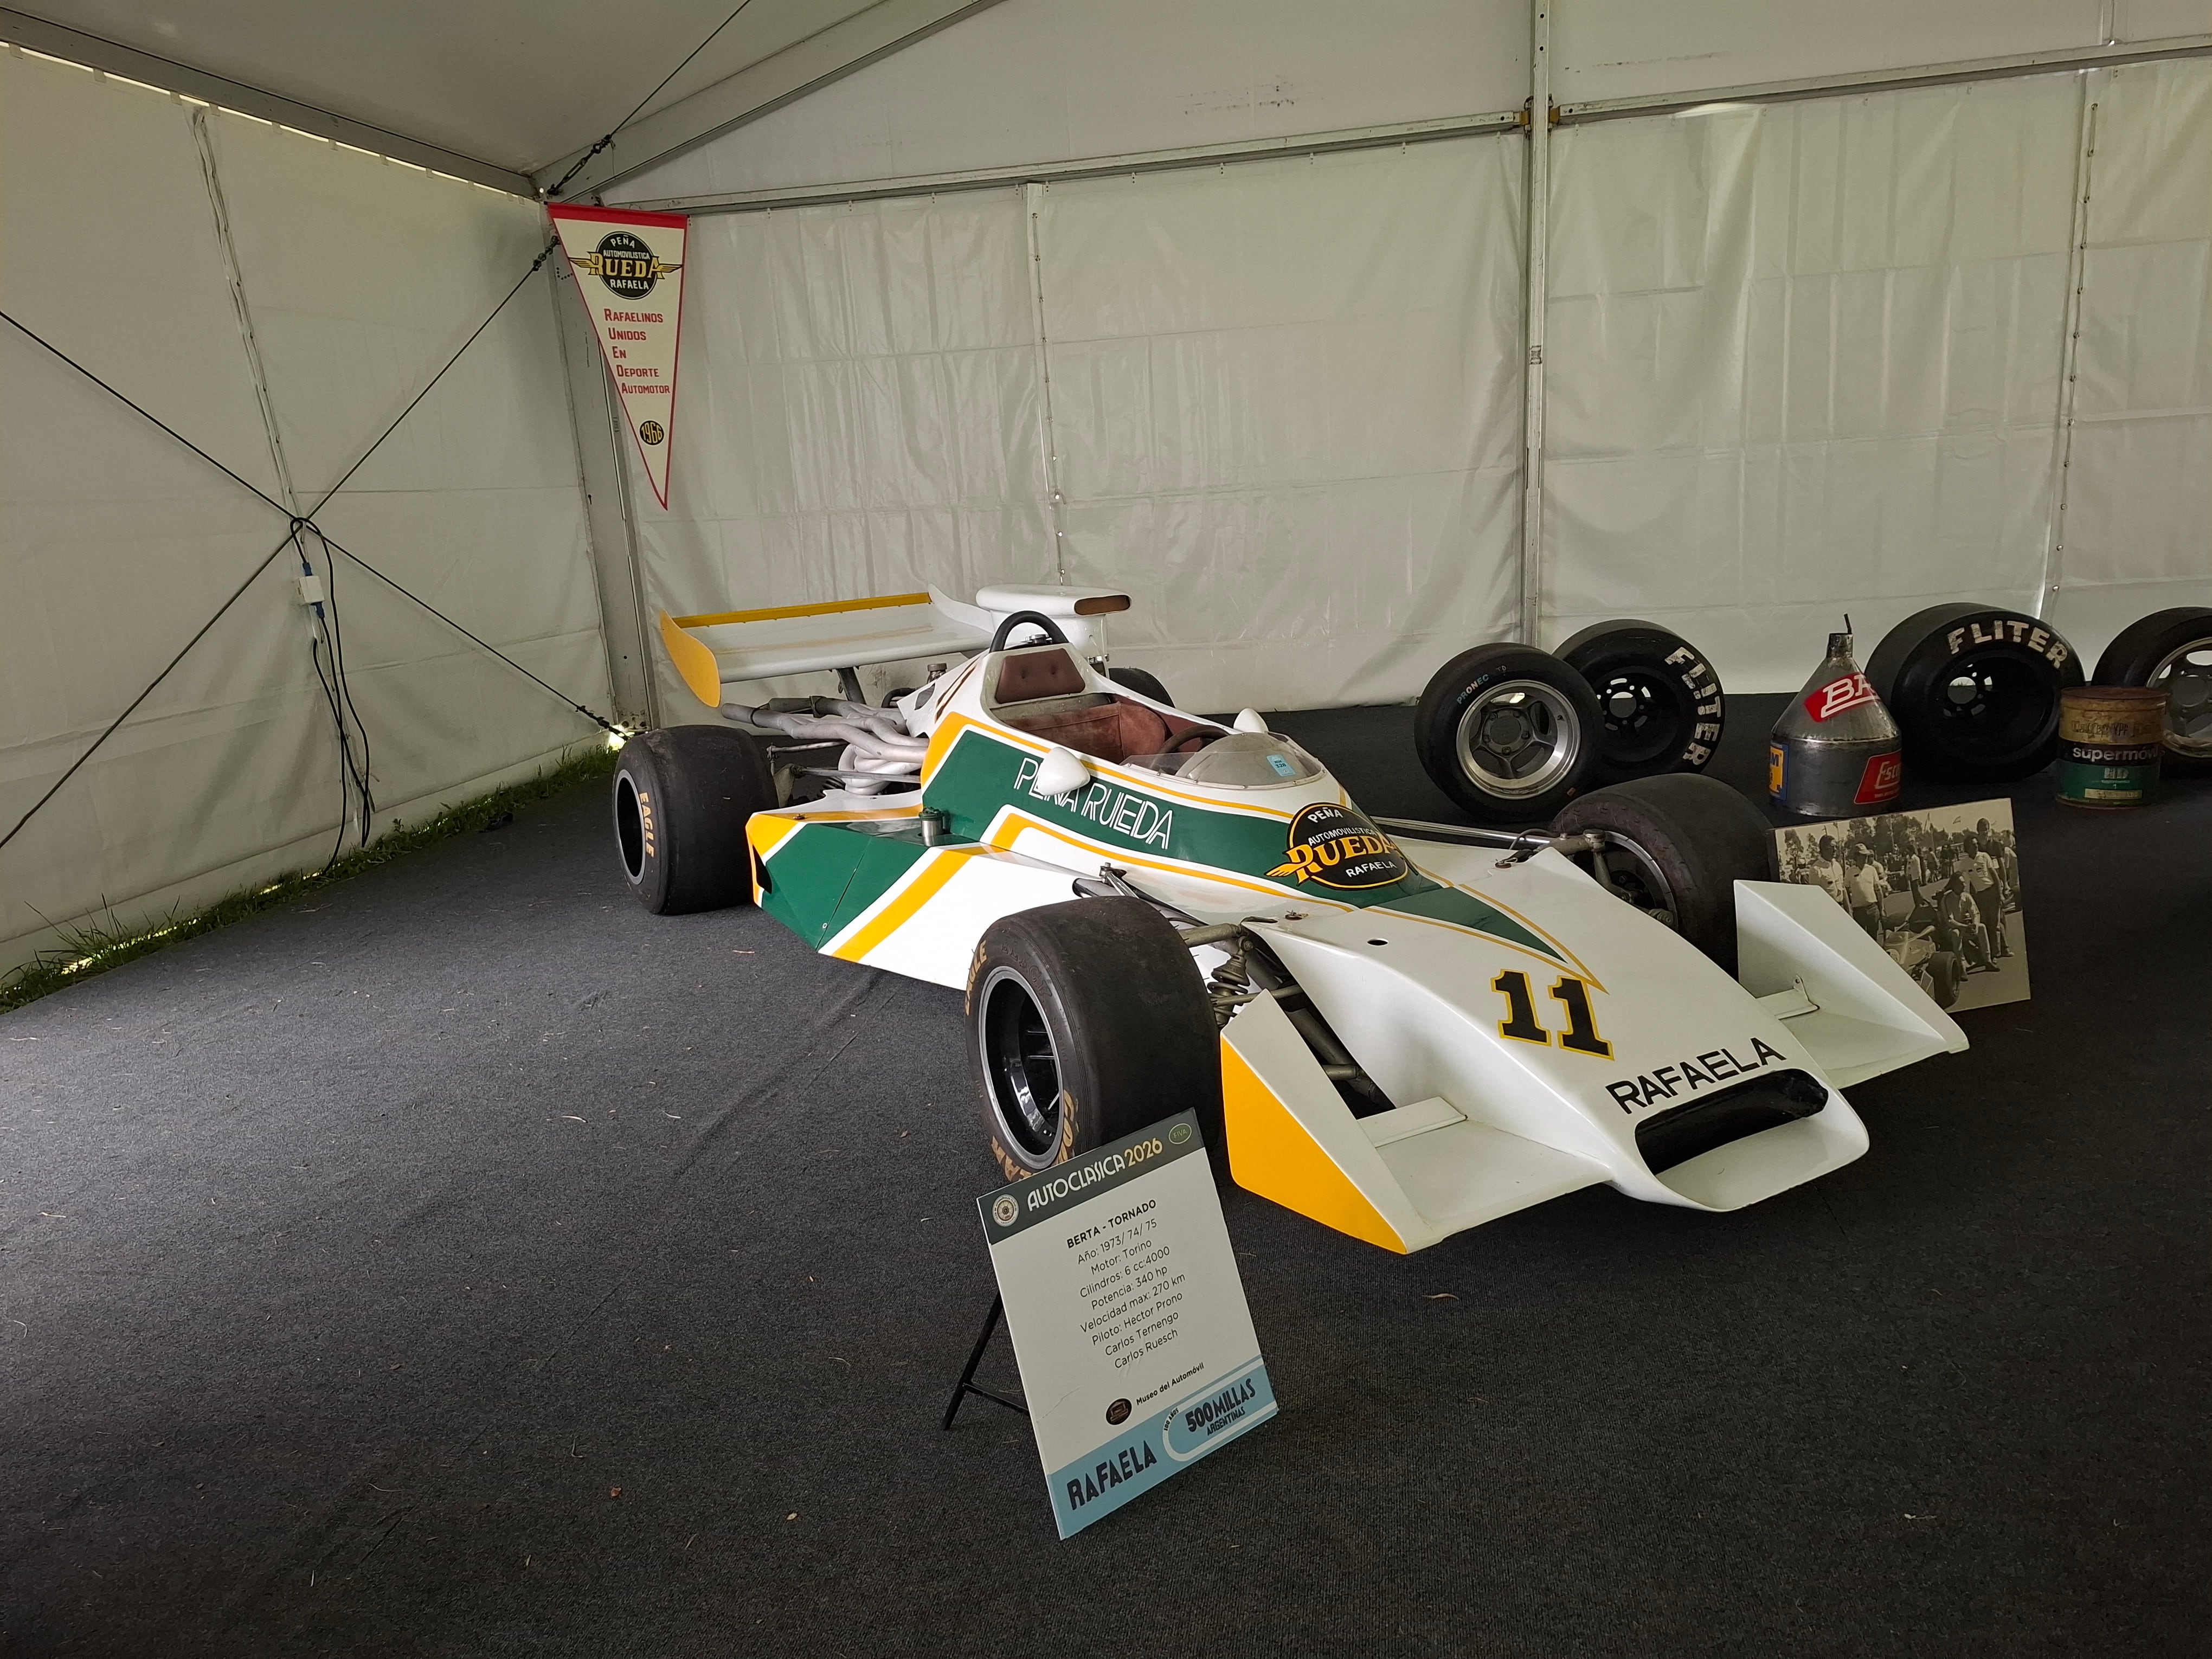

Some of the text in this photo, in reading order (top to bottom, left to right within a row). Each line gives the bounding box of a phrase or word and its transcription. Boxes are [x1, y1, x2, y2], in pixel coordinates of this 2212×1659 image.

[603, 249, 650, 260] AUTOMOVILISTICA
[610, 235, 635, 248] PEÑA
[587, 251, 665, 280] RUEDA
[610, 279, 649, 290] RAFAELA
[641, 422, 663, 443] 1966
[1947, 620, 2068, 669] FLITER
[1456, 674, 1489, 704] PRONEC
[1664, 647, 1721, 766] FLITER
[639, 792, 654, 858] EAGLE
[1013, 757, 1173, 850] PA RUEDA
[1308, 807, 1343, 823] PEÑA
[1285, 831, 1403, 884] RUEDA
[1308, 827, 1378, 846] AUTOMOVILISTICA
[1346, 859, 1397, 878] RAFAELA
[1490, 968, 1615, 1061] 11
[1605, 1037, 1787, 1114] RAFAELA
[1125, 1137, 1163, 1167] 2026
[1173, 1129, 1187, 1139] FIVA
[1067, 1226, 1101, 1249] BERTA
[1108, 1199, 1156, 1228] TORNADO
[1078, 1248, 1099, 1264] Año:
[1101, 1231, 1125, 1252] 1973/
[1146, 1218, 1157, 1231] 75
[1080, 1246, 1170, 1297] Cilindros: 6 cc:4000
[1091, 1240, 1152, 1275] Motor: Torino
[1080, 1274, 1186, 1333] Velocidad max: 270 km
[1091, 1266, 1167, 1310] Potencia: 340 hp
[1092, 1293, 1182, 1346] Piloto: Hector Prono
[1105, 1312, 1179, 1355] Carlos Ternengo
[1114, 1328, 1178, 1368] Carlos Ruesch
[1136, 1361, 1204, 1406] Museo del Automóvil
[1206, 1406, 1245, 1436] ARGENTINAS
[1066, 1440, 1157, 1510] RAFAELA
